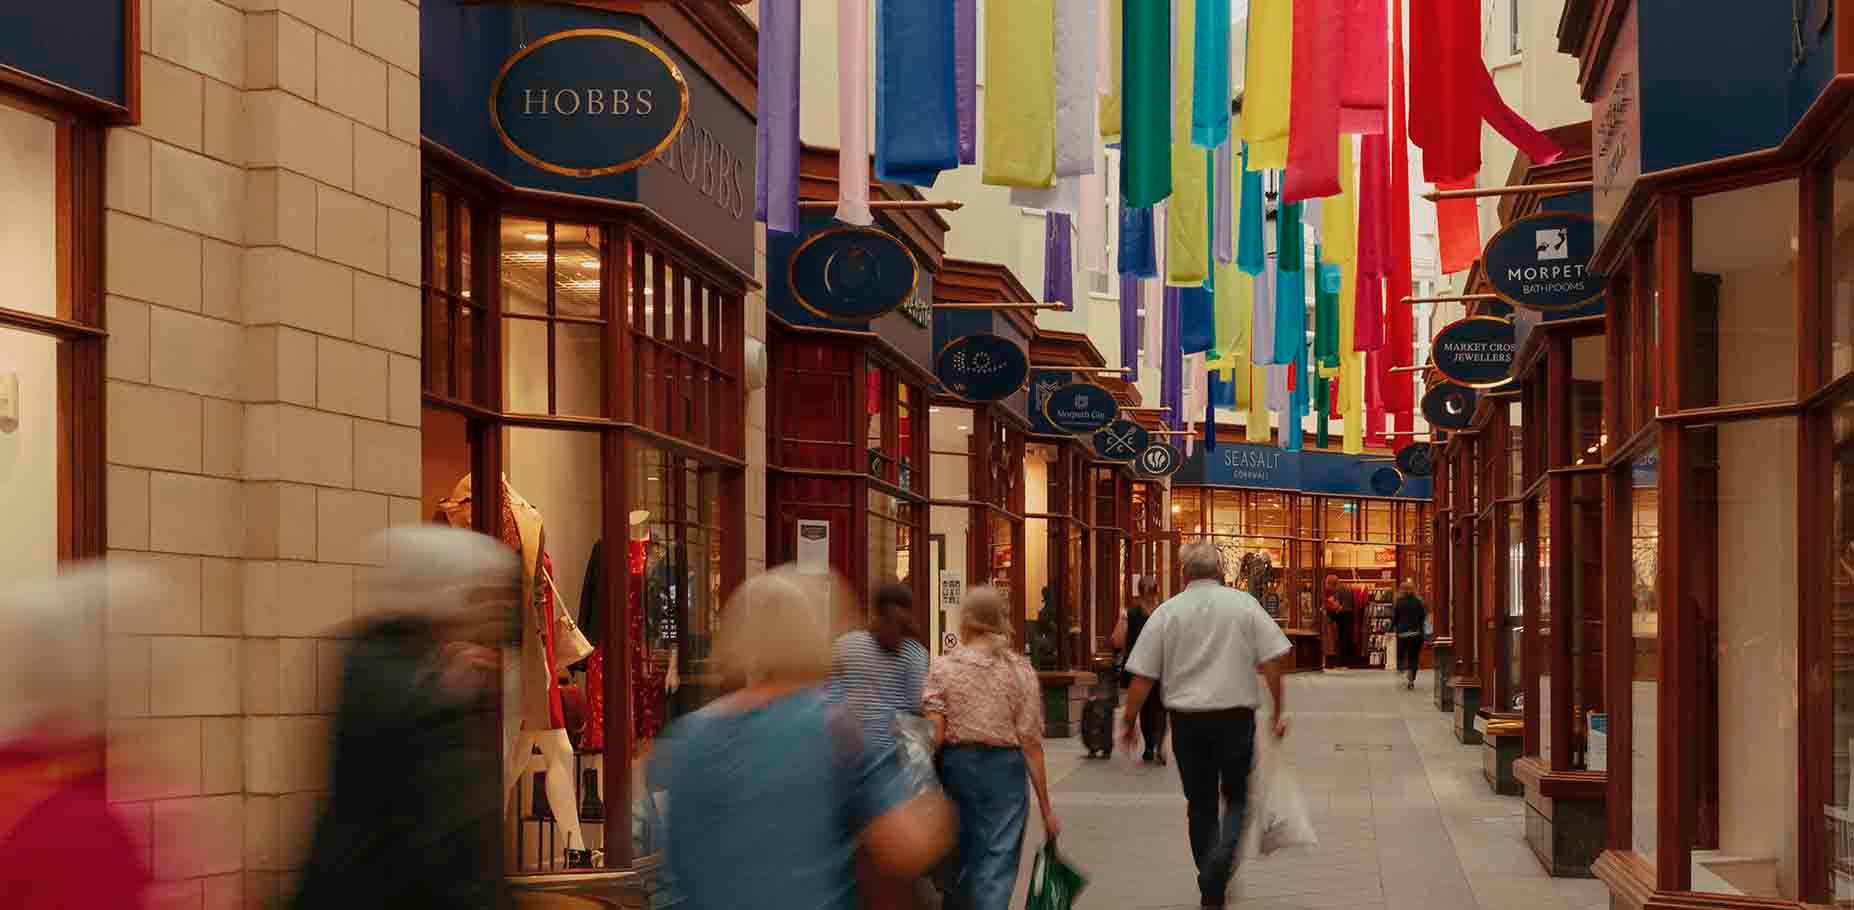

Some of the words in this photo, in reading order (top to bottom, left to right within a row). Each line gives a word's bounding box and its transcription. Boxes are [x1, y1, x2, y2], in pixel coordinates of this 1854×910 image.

[522, 88, 655, 116] HOBBS
[654, 116, 743, 219] OBBS
[1507, 264, 1586, 281] MORPET
[1443, 343, 1488, 352] MARKET
[1455, 353, 1512, 362] JEWELLERS
[1224, 448, 1281, 470] SEASALT
